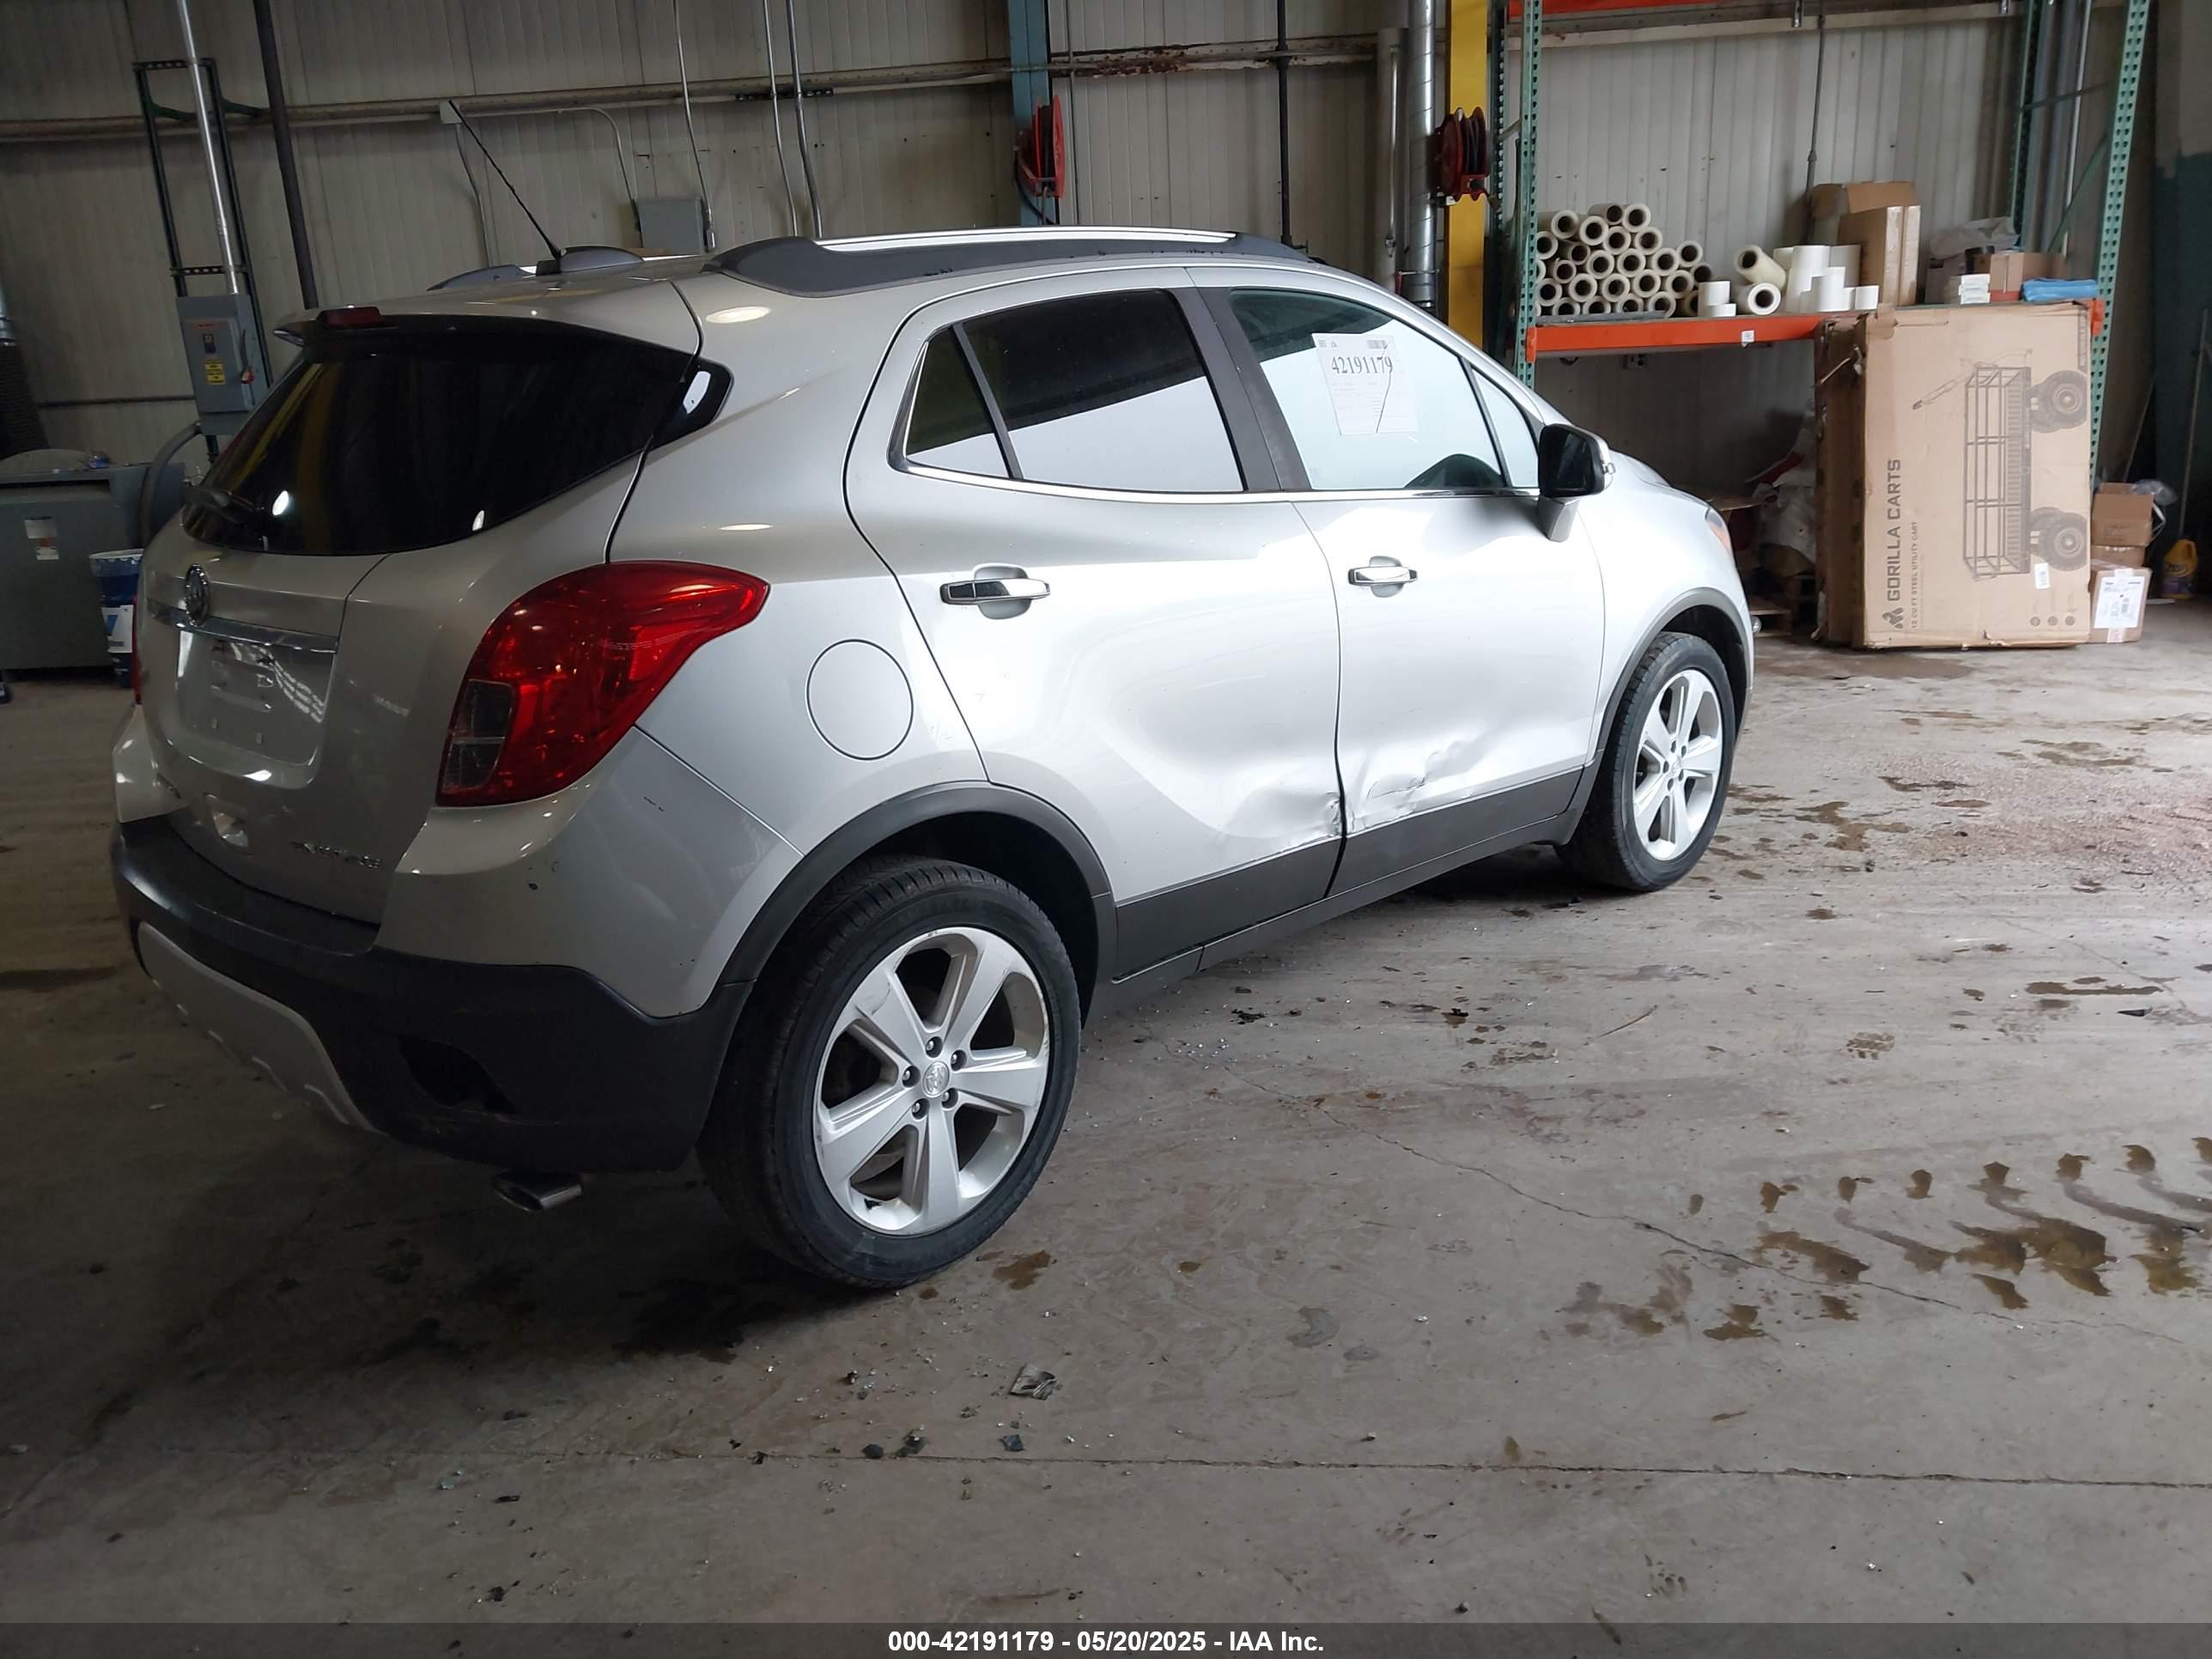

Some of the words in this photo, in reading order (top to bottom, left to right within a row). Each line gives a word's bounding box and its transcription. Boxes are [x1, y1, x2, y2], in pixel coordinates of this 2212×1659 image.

[1331, 356, 1393, 374] 42191179
[1887, 459, 1900, 520] CARTS
[1887, 526, 1900, 601] GORILLA
